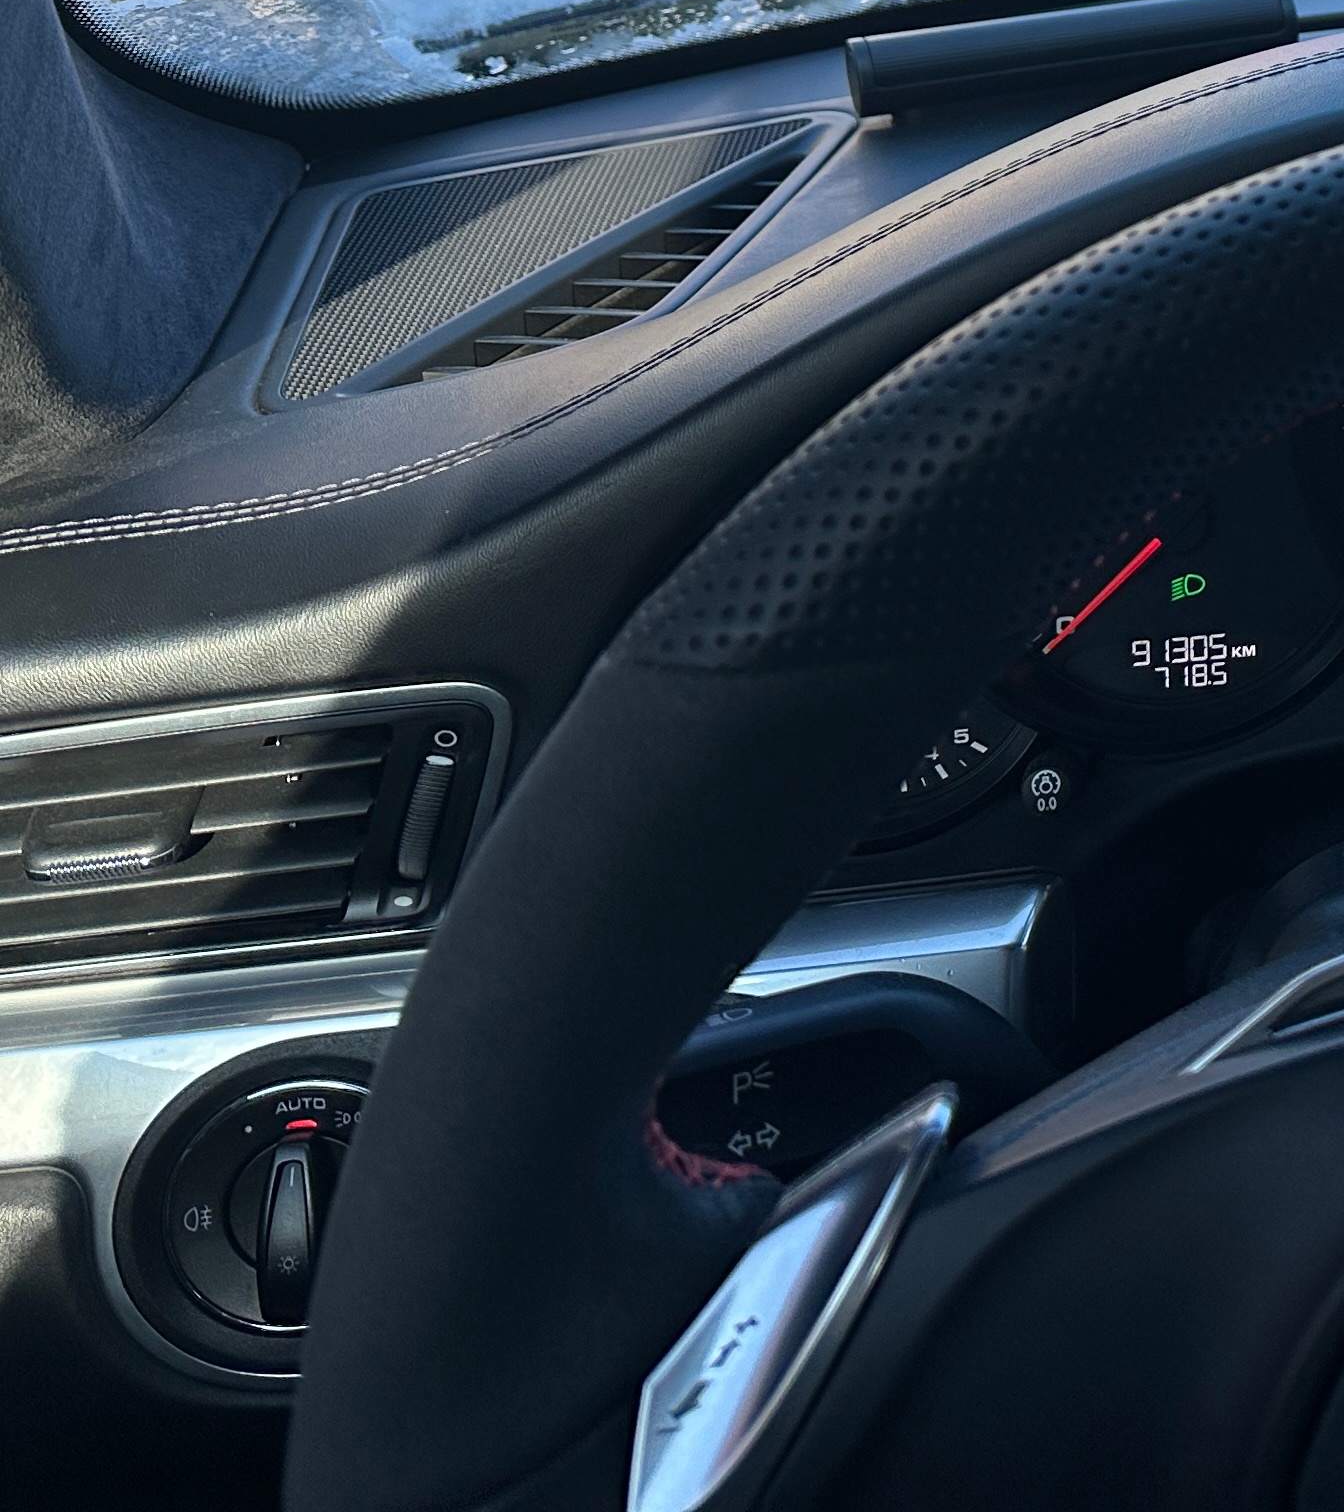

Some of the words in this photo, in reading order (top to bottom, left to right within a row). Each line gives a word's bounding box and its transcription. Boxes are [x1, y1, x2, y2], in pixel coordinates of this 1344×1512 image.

[1131, 633, 1228, 667] 91305
[1232, 644, 1256, 658] KM
[1155, 661, 1228, 688] 718.5
[953, 728, 970, 744] 5
[1037, 796, 1057, 812] 0.0
[276, 1097, 326, 1115] AUTO
